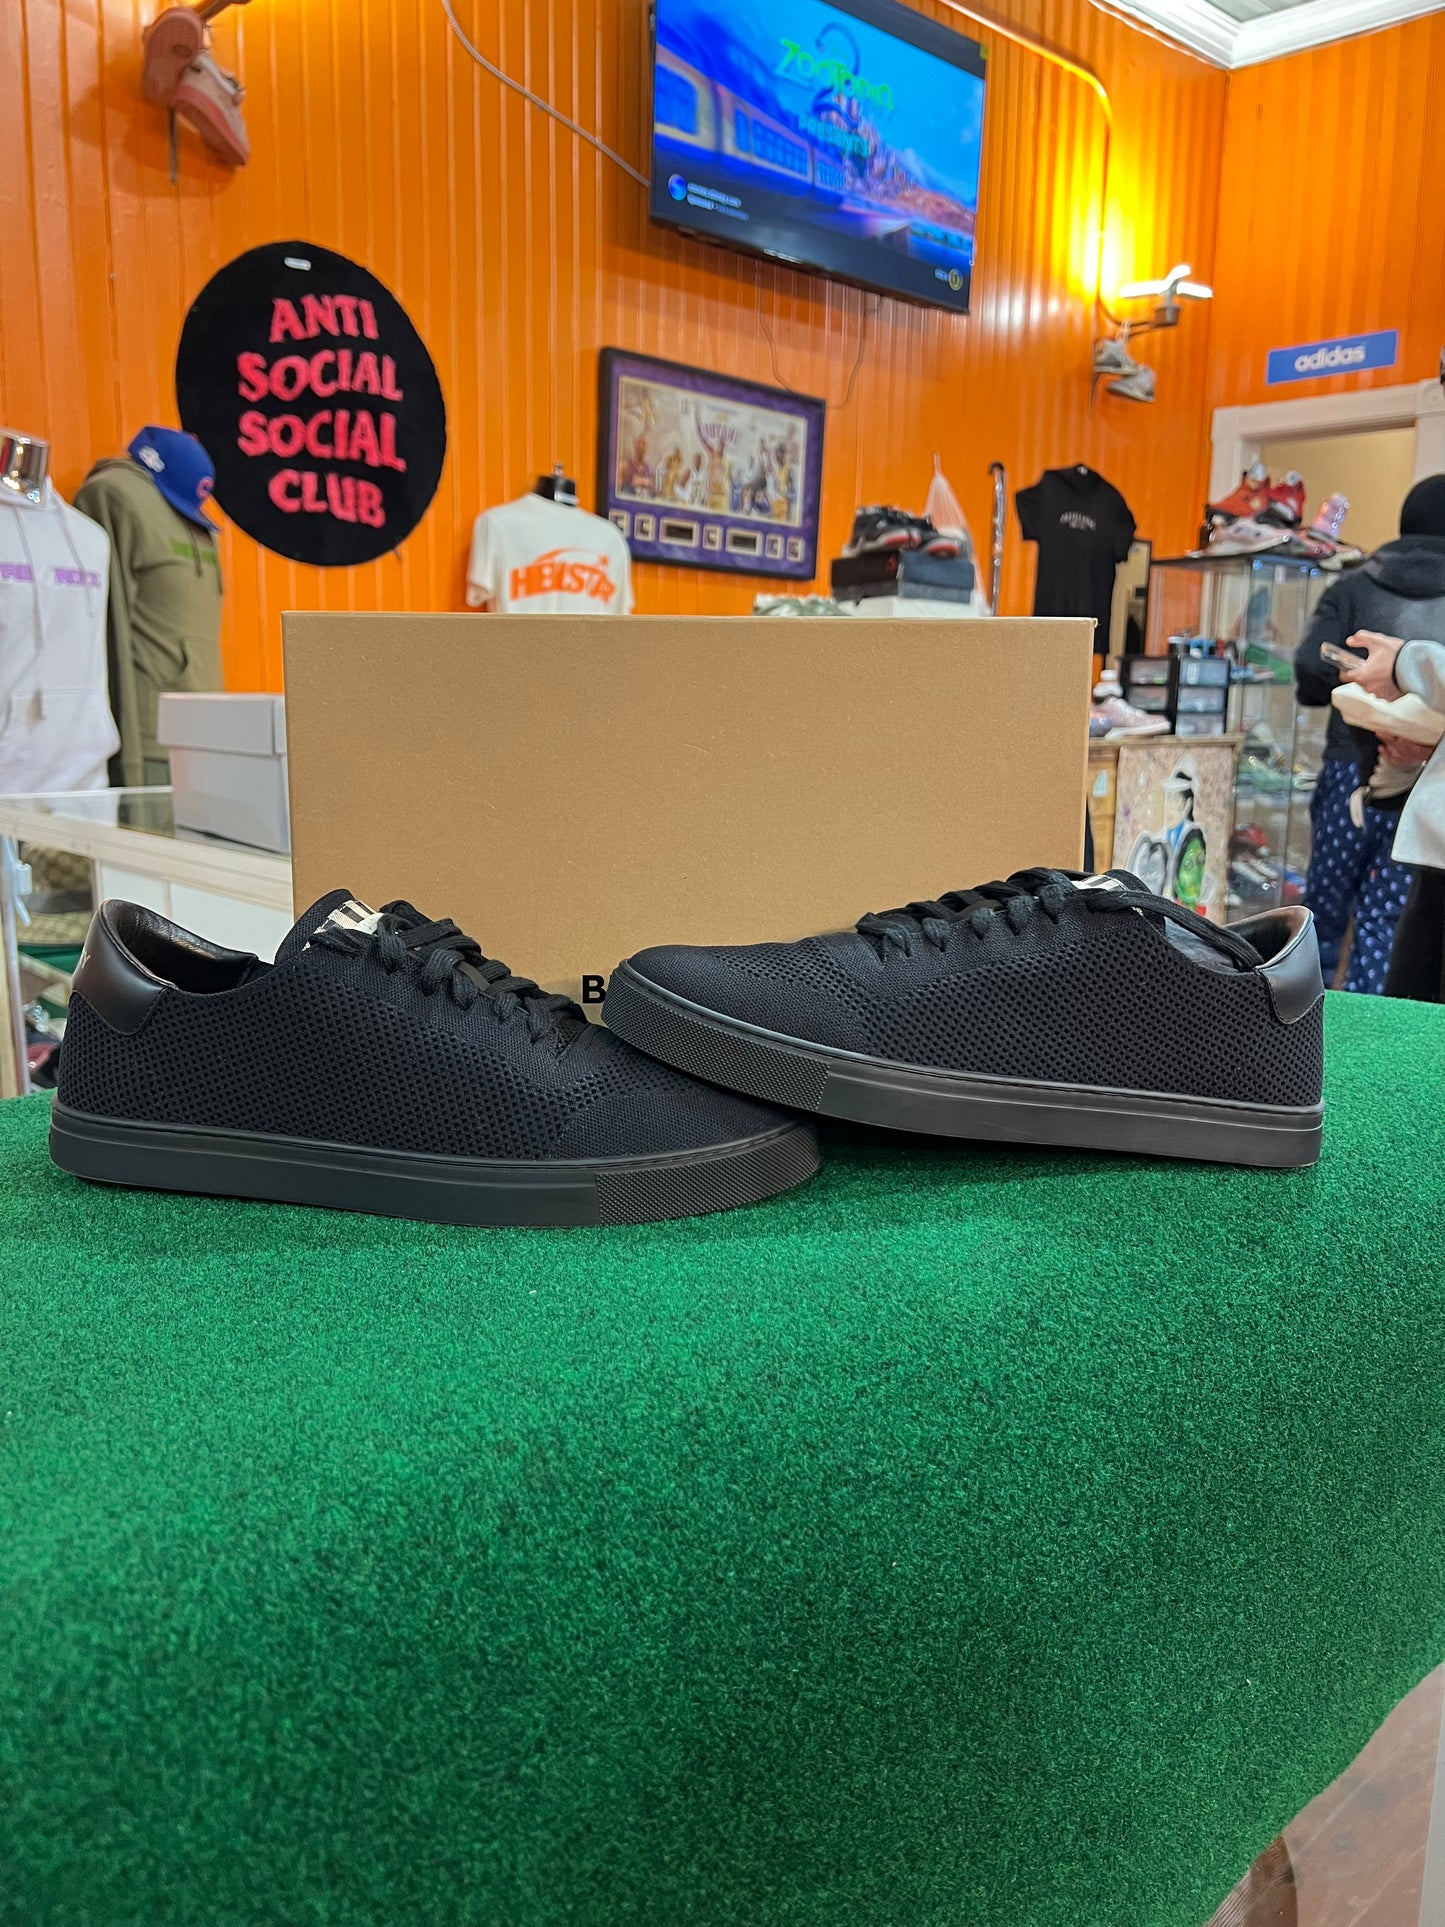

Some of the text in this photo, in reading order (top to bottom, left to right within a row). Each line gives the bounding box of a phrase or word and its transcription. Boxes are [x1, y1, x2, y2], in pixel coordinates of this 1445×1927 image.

[269, 293, 379, 343] ANTI
[236, 349, 403, 402] SOCIAL
[1294, 344, 1366, 372] adidas
[237, 409, 407, 472] SOCIAL
[268, 468, 386, 528] CLUB
